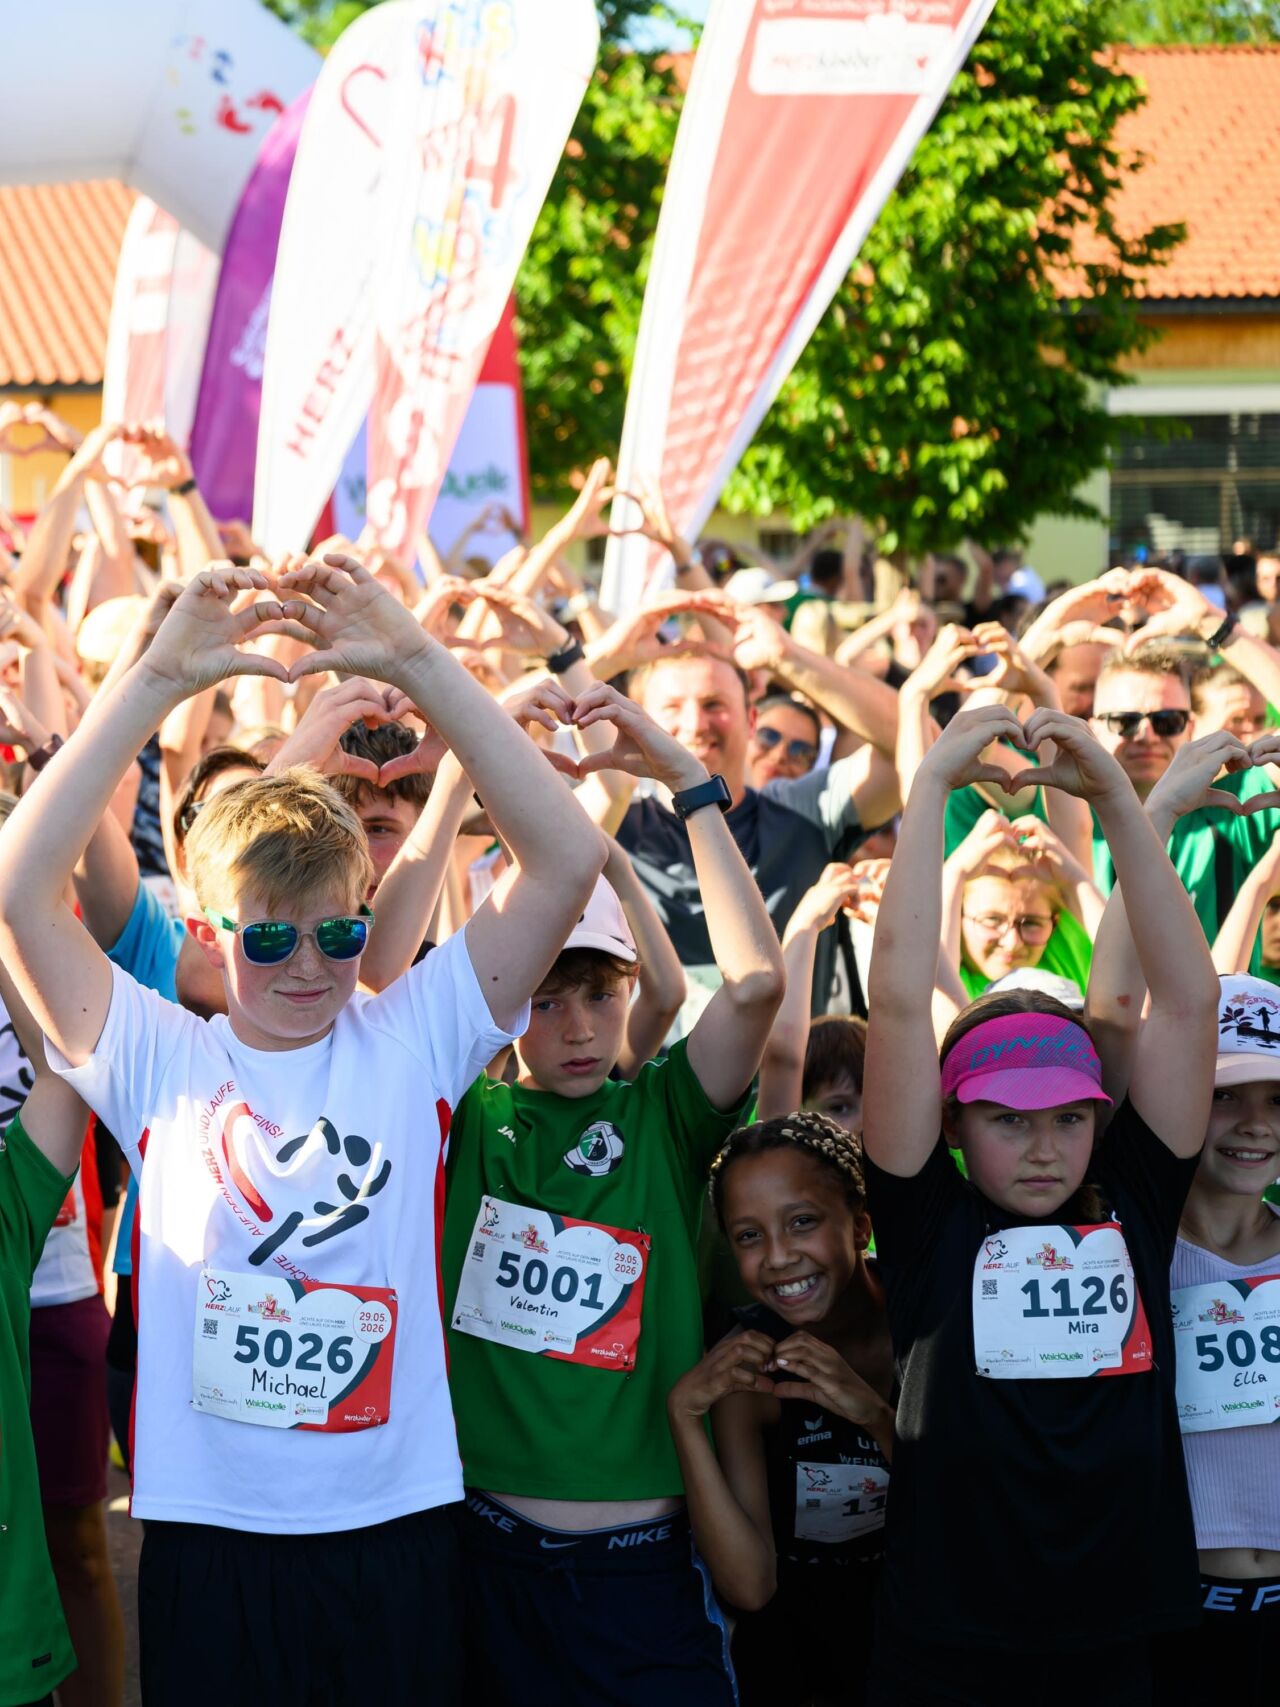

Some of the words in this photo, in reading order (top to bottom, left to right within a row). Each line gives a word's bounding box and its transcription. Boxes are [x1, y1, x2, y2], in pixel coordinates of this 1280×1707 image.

[206, 1080, 236, 1118] LAUFE
[251, 1112, 285, 1139] EINS!
[201, 1147, 225, 1185] HERZ
[614, 1252, 639, 1266] 29.05.
[614, 1264, 637, 1276] 2026
[495, 1251, 605, 1311] 5001
[1021, 1273, 1128, 1318] 1126
[205, 1302, 241, 1314] HERZLAUF
[510, 1295, 559, 1318] Valentin
[359, 1311, 387, 1323] 29.05.
[360, 1323, 385, 1333] 2026
[501, 1319, 537, 1337] WaldQuelle
[1068, 1321, 1099, 1334] Mira
[233, 1324, 354, 1374] 5026
[1039, 1352, 1084, 1362] WaldQuelle
[251, 1368, 327, 1399] Michael
[1233, 1371, 1268, 1387] Ella
[245, 1397, 286, 1411] WaldQuelle
[1221, 1400, 1265, 1413] WaldQuelle
[797, 1430, 833, 1446] erima
[607, 1524, 673, 1550] NIKE
